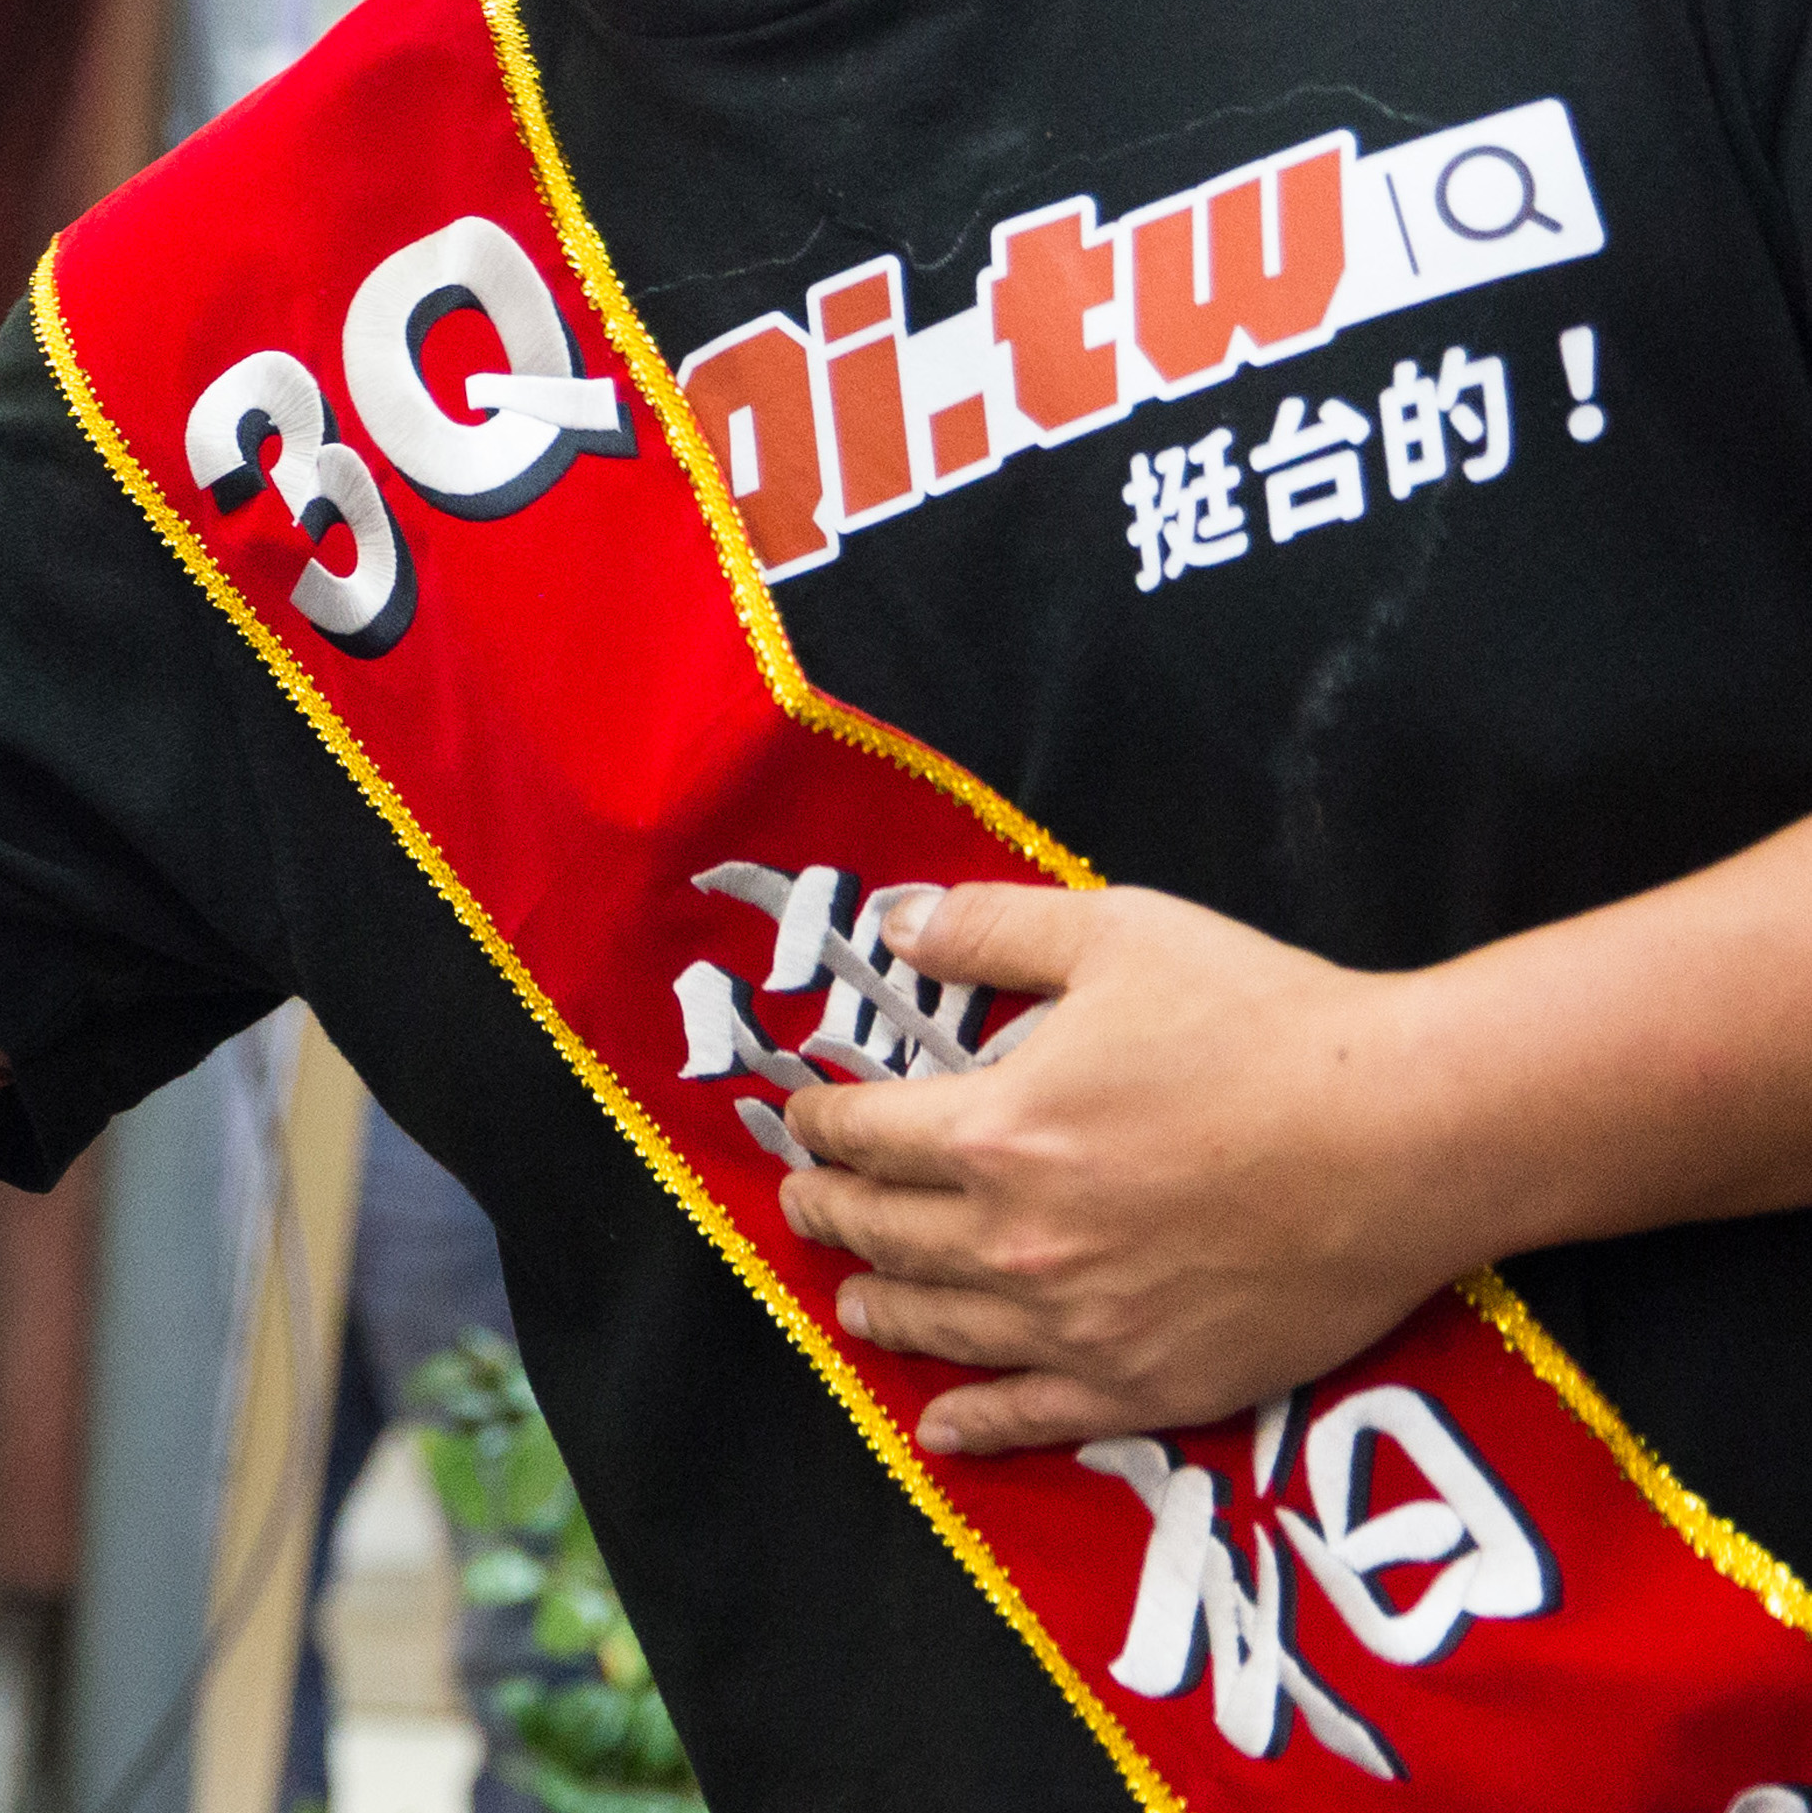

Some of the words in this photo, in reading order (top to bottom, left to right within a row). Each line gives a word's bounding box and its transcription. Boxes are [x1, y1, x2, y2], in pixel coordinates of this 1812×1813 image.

[184, 215, 639, 660] 3Q
[1123, 325, 1607, 593] 挺台的！
